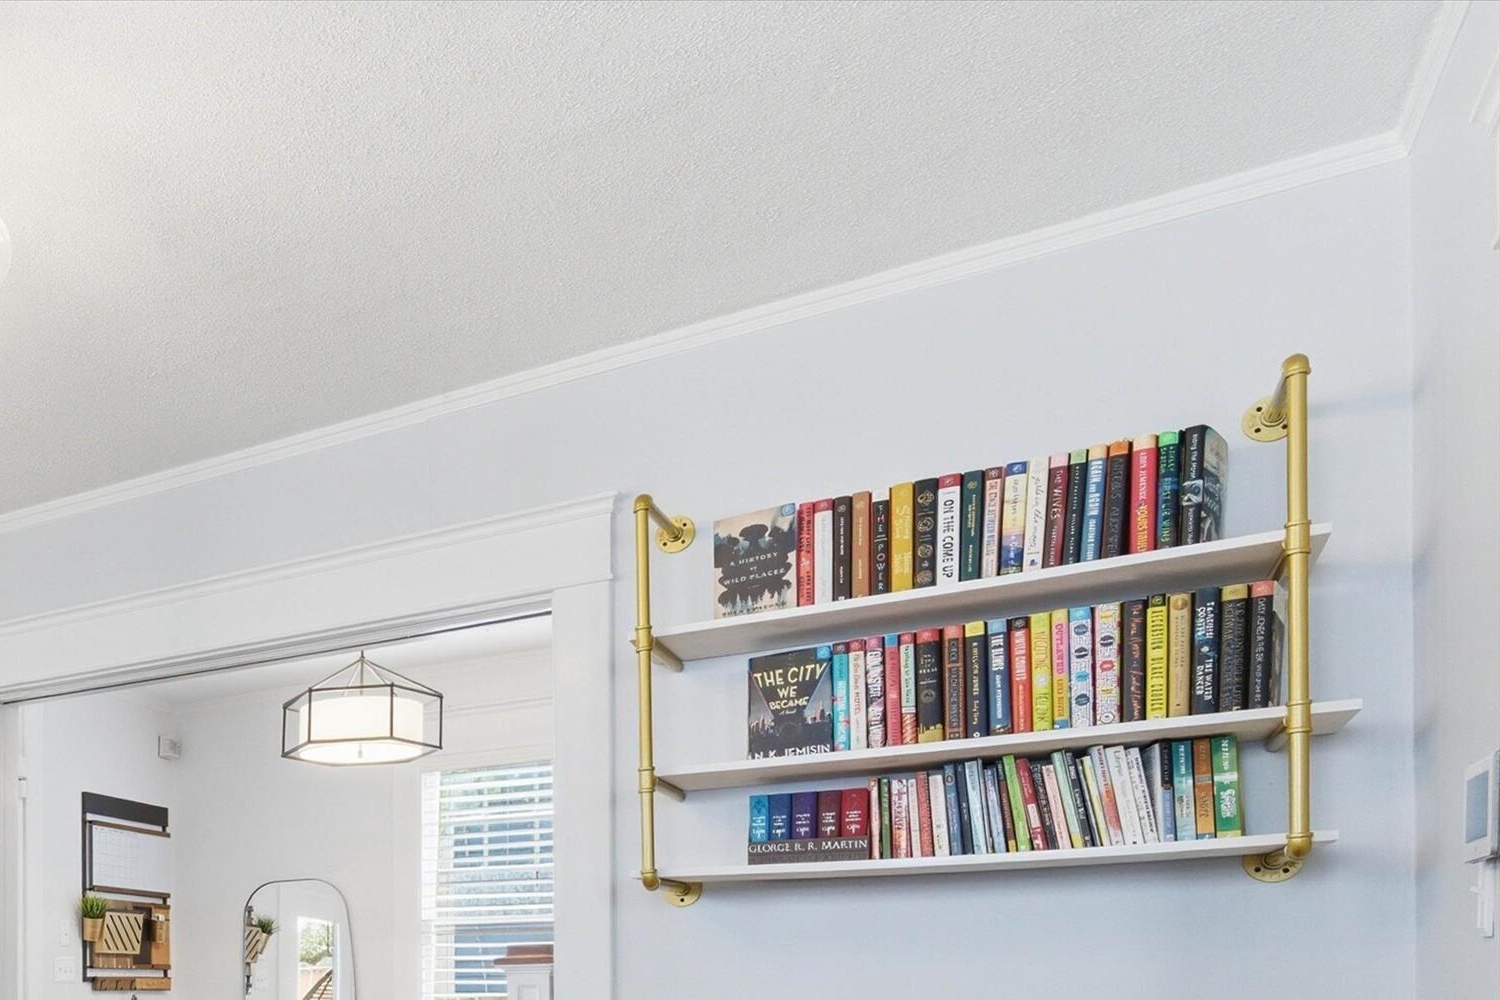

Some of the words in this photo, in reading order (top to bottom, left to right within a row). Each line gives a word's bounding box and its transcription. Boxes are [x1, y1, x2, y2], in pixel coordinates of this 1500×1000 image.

[943, 499, 956, 515] ON
[1050, 485, 1064, 520] WIVES
[942, 515, 955, 533] THE
[1160, 518, 1171, 543] WINS
[941, 535, 955, 563] COME
[941, 564, 955, 580] UP
[723, 576, 747, 586] WILD
[1055, 623, 1065, 675] OUTLAWED
[754, 668, 785, 688] THE
[787, 662, 828, 684] CITY
[777, 685, 798, 699] WE
[768, 696, 810, 711] BECAME
[784, 744, 831, 758] JEMISIN
[748, 842, 791, 854] GEORGE
[807, 840, 818, 851] R.
[821, 838, 869, 851] MARTIN
